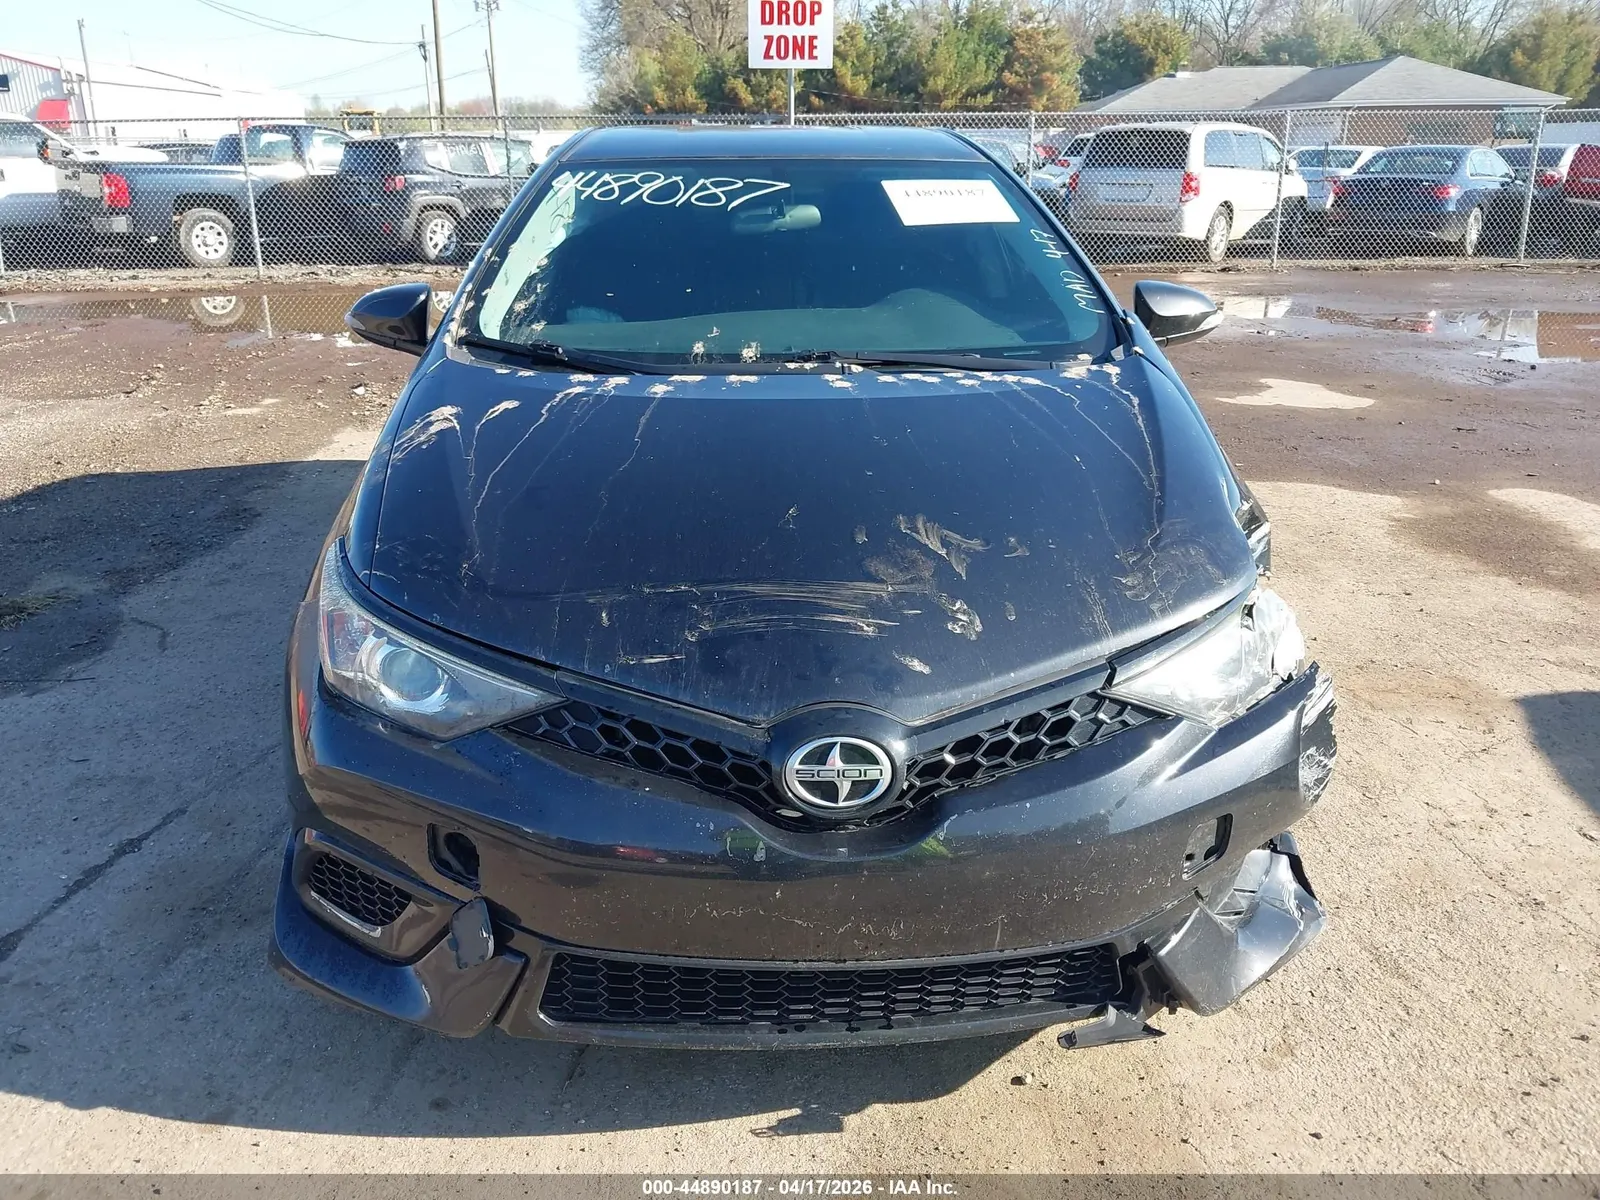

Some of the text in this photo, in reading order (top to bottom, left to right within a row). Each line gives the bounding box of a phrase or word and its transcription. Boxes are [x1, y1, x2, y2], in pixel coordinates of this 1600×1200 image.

[760, 0, 822, 26] DROP
[763, 34, 819, 61] ZONE
[551, 170, 791, 212] 44890187
